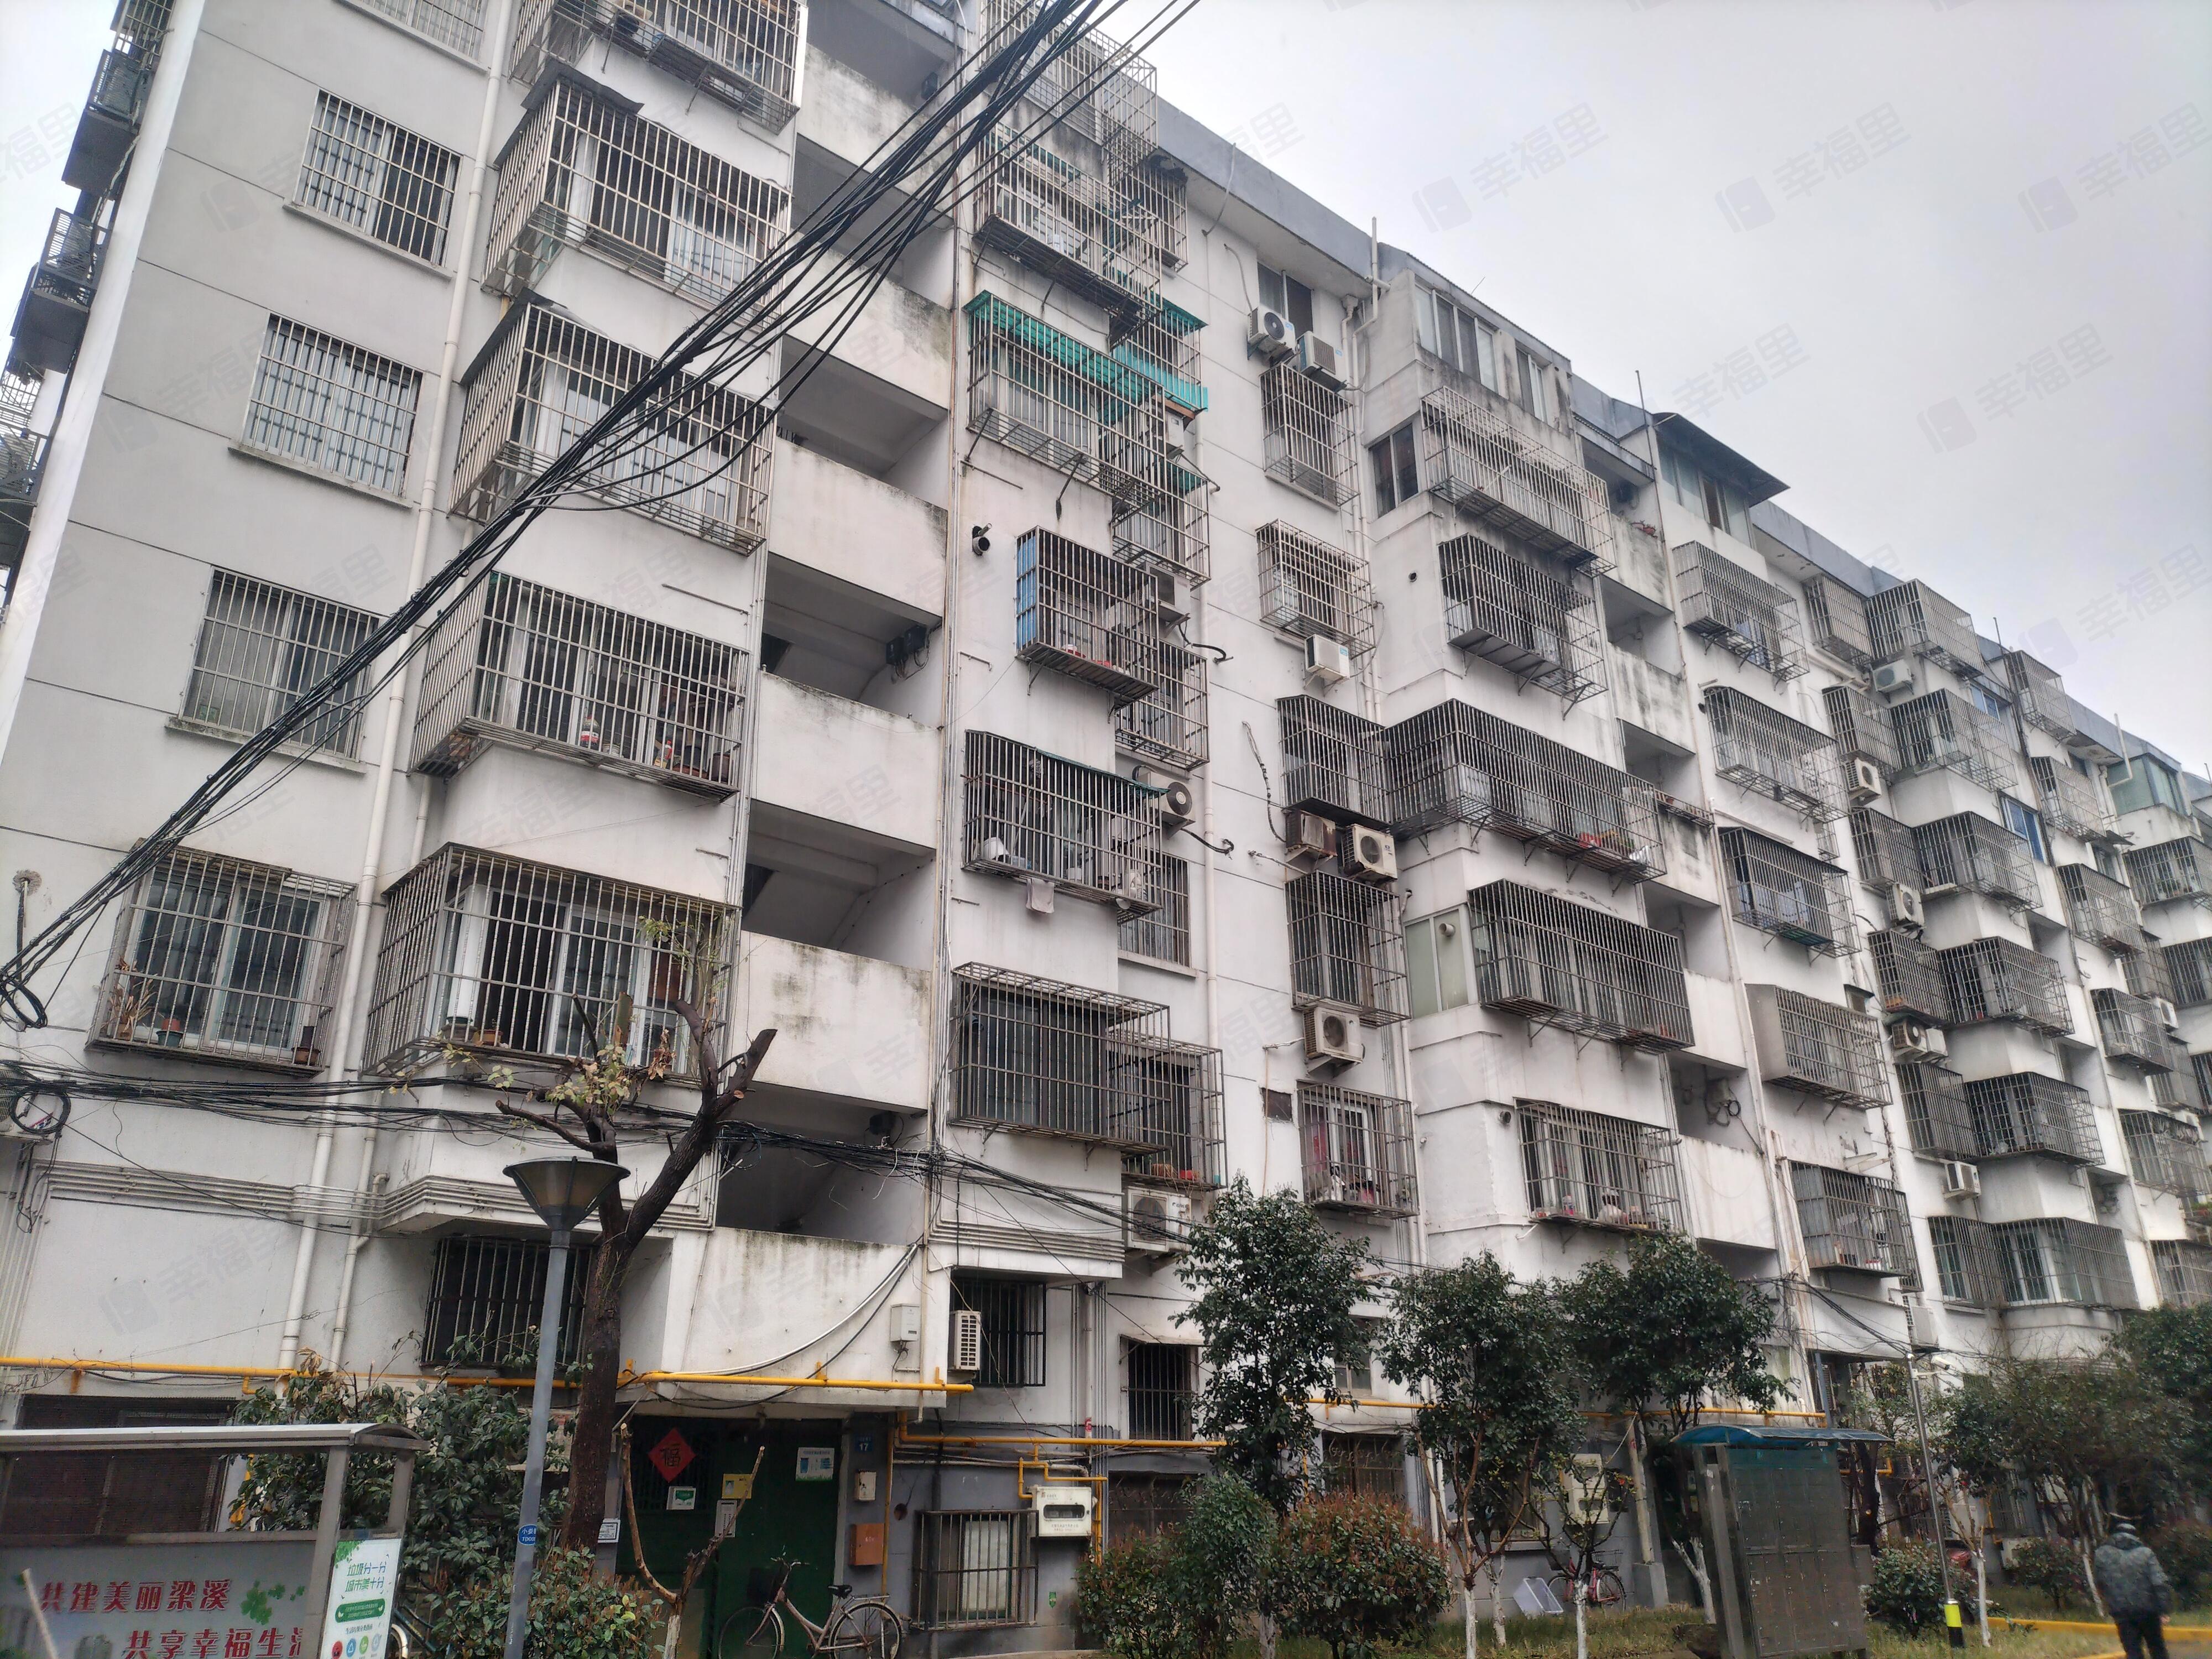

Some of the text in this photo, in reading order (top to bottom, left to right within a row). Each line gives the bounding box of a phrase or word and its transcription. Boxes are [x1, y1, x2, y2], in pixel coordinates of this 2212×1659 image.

[660, 1443, 681, 1467] 福
[347, 1561, 387, 1577] 垃圾分一分
[345, 1576, 385, 1593] 城市美十分
[42, 1579, 231, 1613] 共建美丽梁溪
